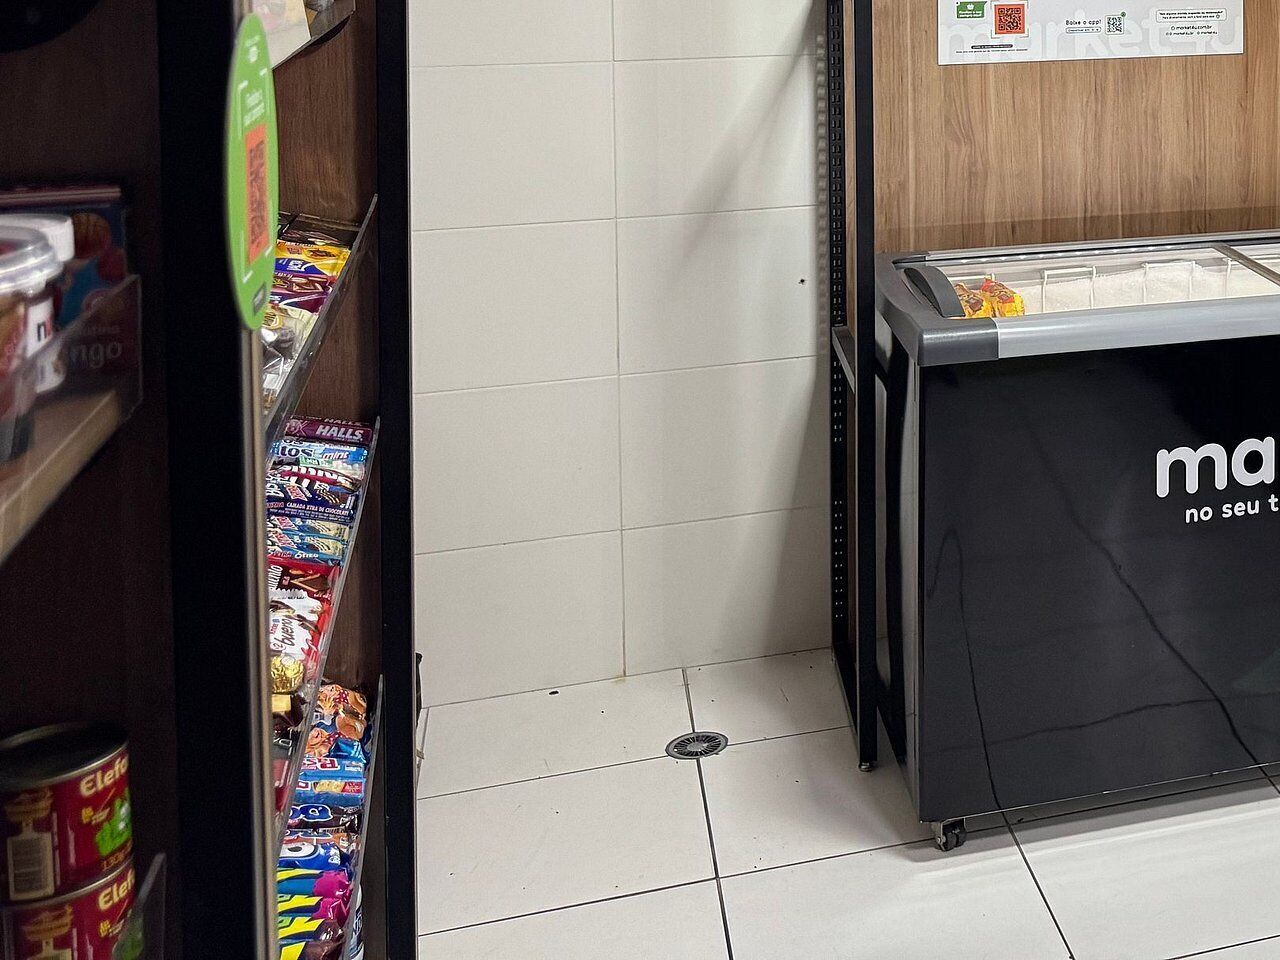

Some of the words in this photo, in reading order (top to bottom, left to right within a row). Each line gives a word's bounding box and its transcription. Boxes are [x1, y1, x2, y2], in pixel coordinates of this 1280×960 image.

[321, 451, 349, 460] mint
[1185, 504, 1213, 524] no
[1221, 500, 1260, 519] seu
[98, 868, 135, 912] Elef
